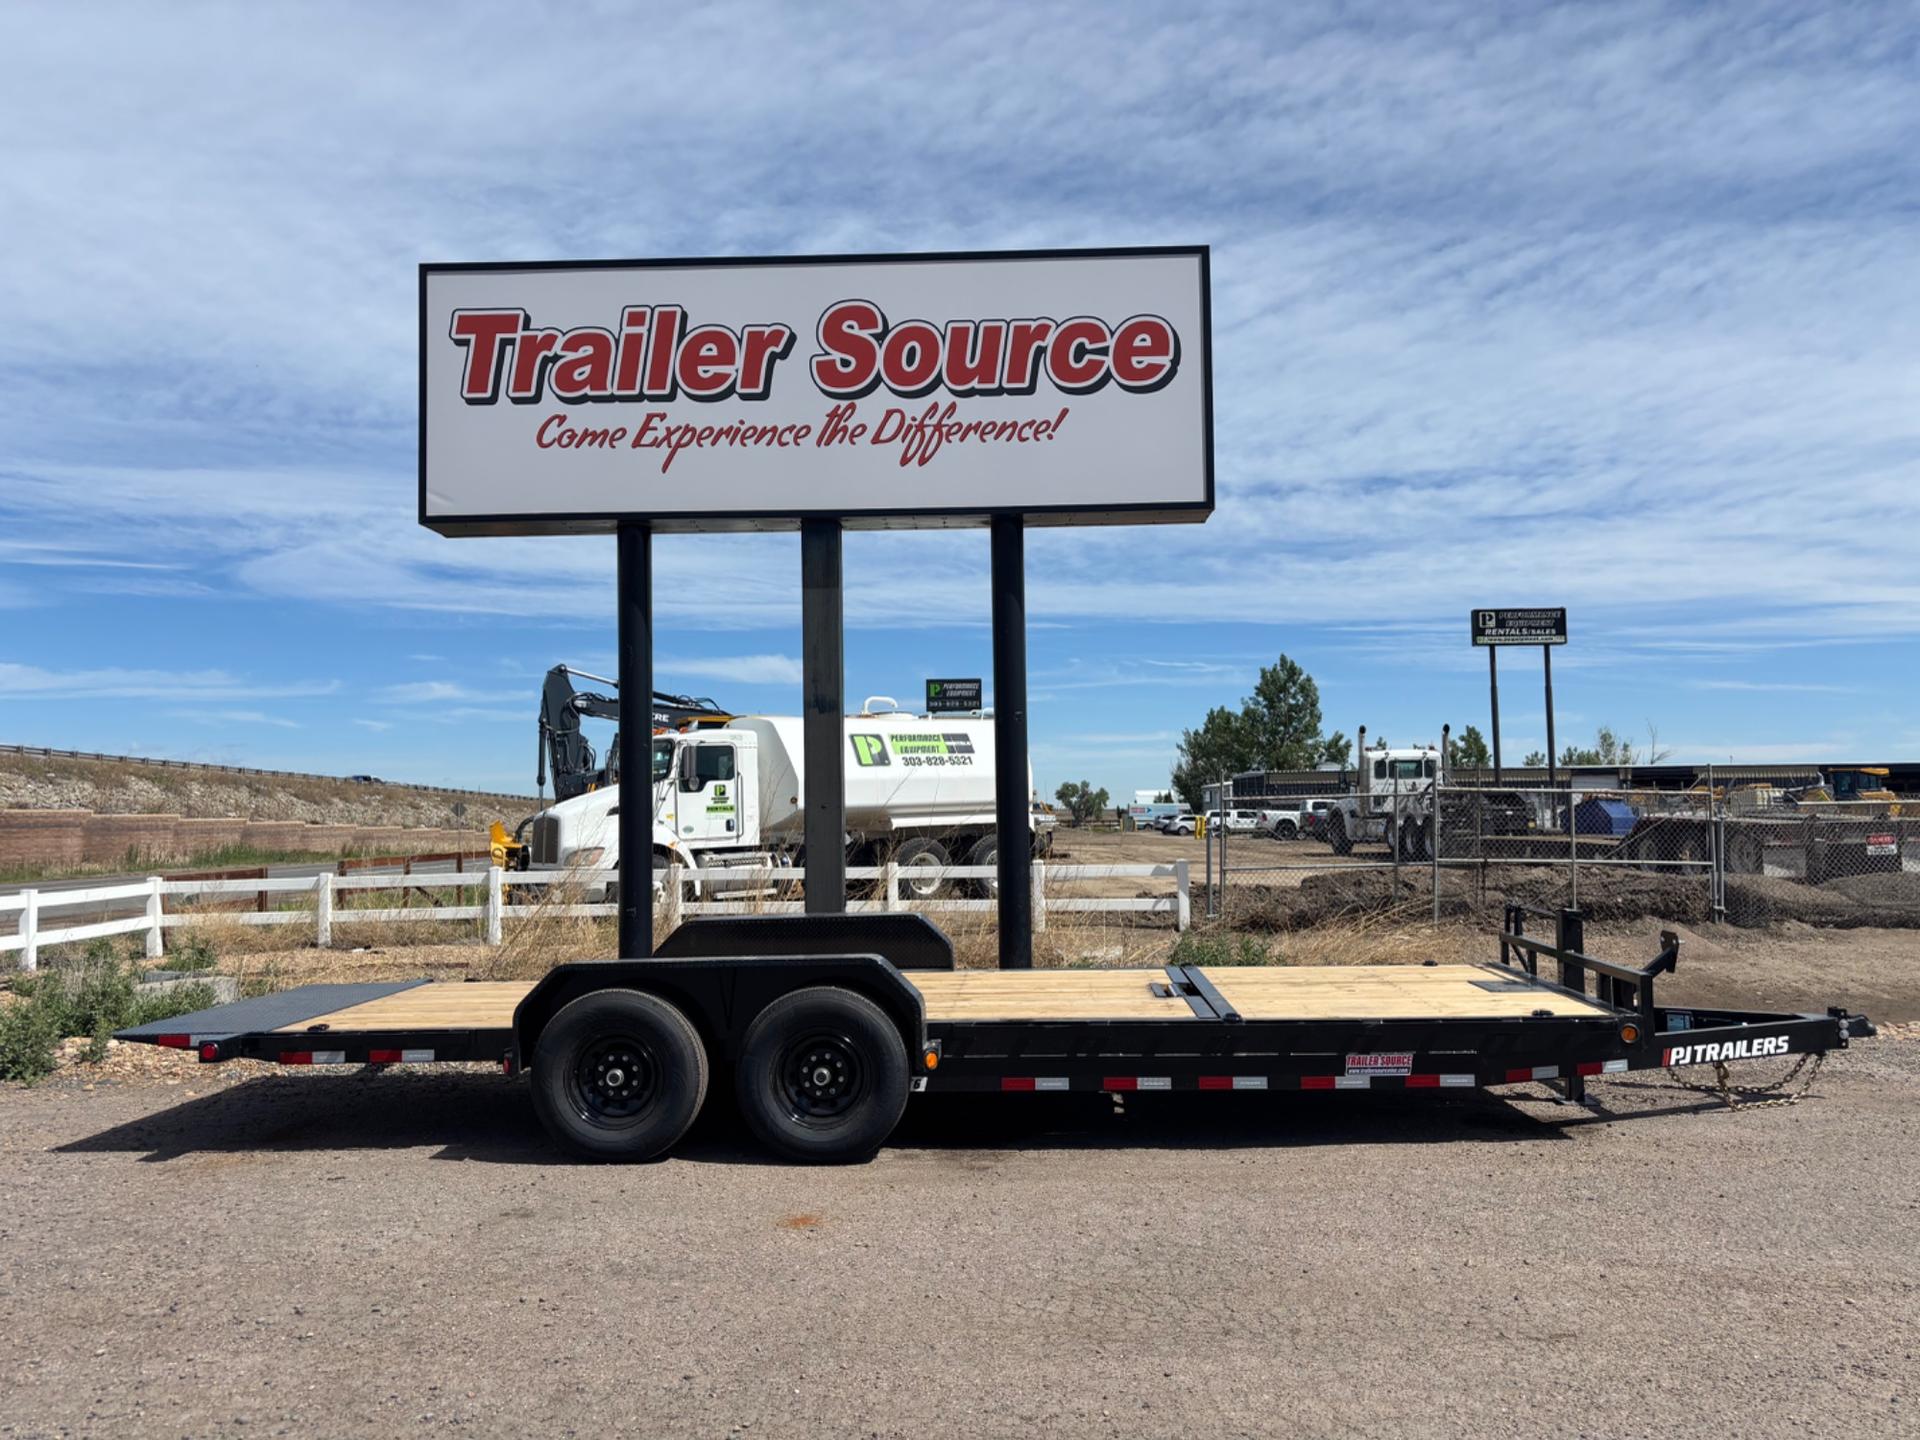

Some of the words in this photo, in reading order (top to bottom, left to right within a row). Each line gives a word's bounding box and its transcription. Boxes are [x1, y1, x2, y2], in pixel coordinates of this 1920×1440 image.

[450, 304, 797, 405] Trailer
[809, 298, 1181, 400] Source
[535, 413, 627, 449] Come
[631, 412, 812, 474] Experience
[815, 401, 867, 448] the
[870, 401, 1070, 467] Difference!
[890, 733, 941, 742] PERFORMANCE
[899, 745, 941, 754] EQUIPMENT
[902, 756, 973, 767] 303-828-5321
[1670, 1046, 1692, 1065] PJ
[1694, 1035, 1789, 1063] TRAILERS
[1347, 1055, 1379, 1066] TRAILER
[1380, 1055, 1412, 1066] SOURCE
